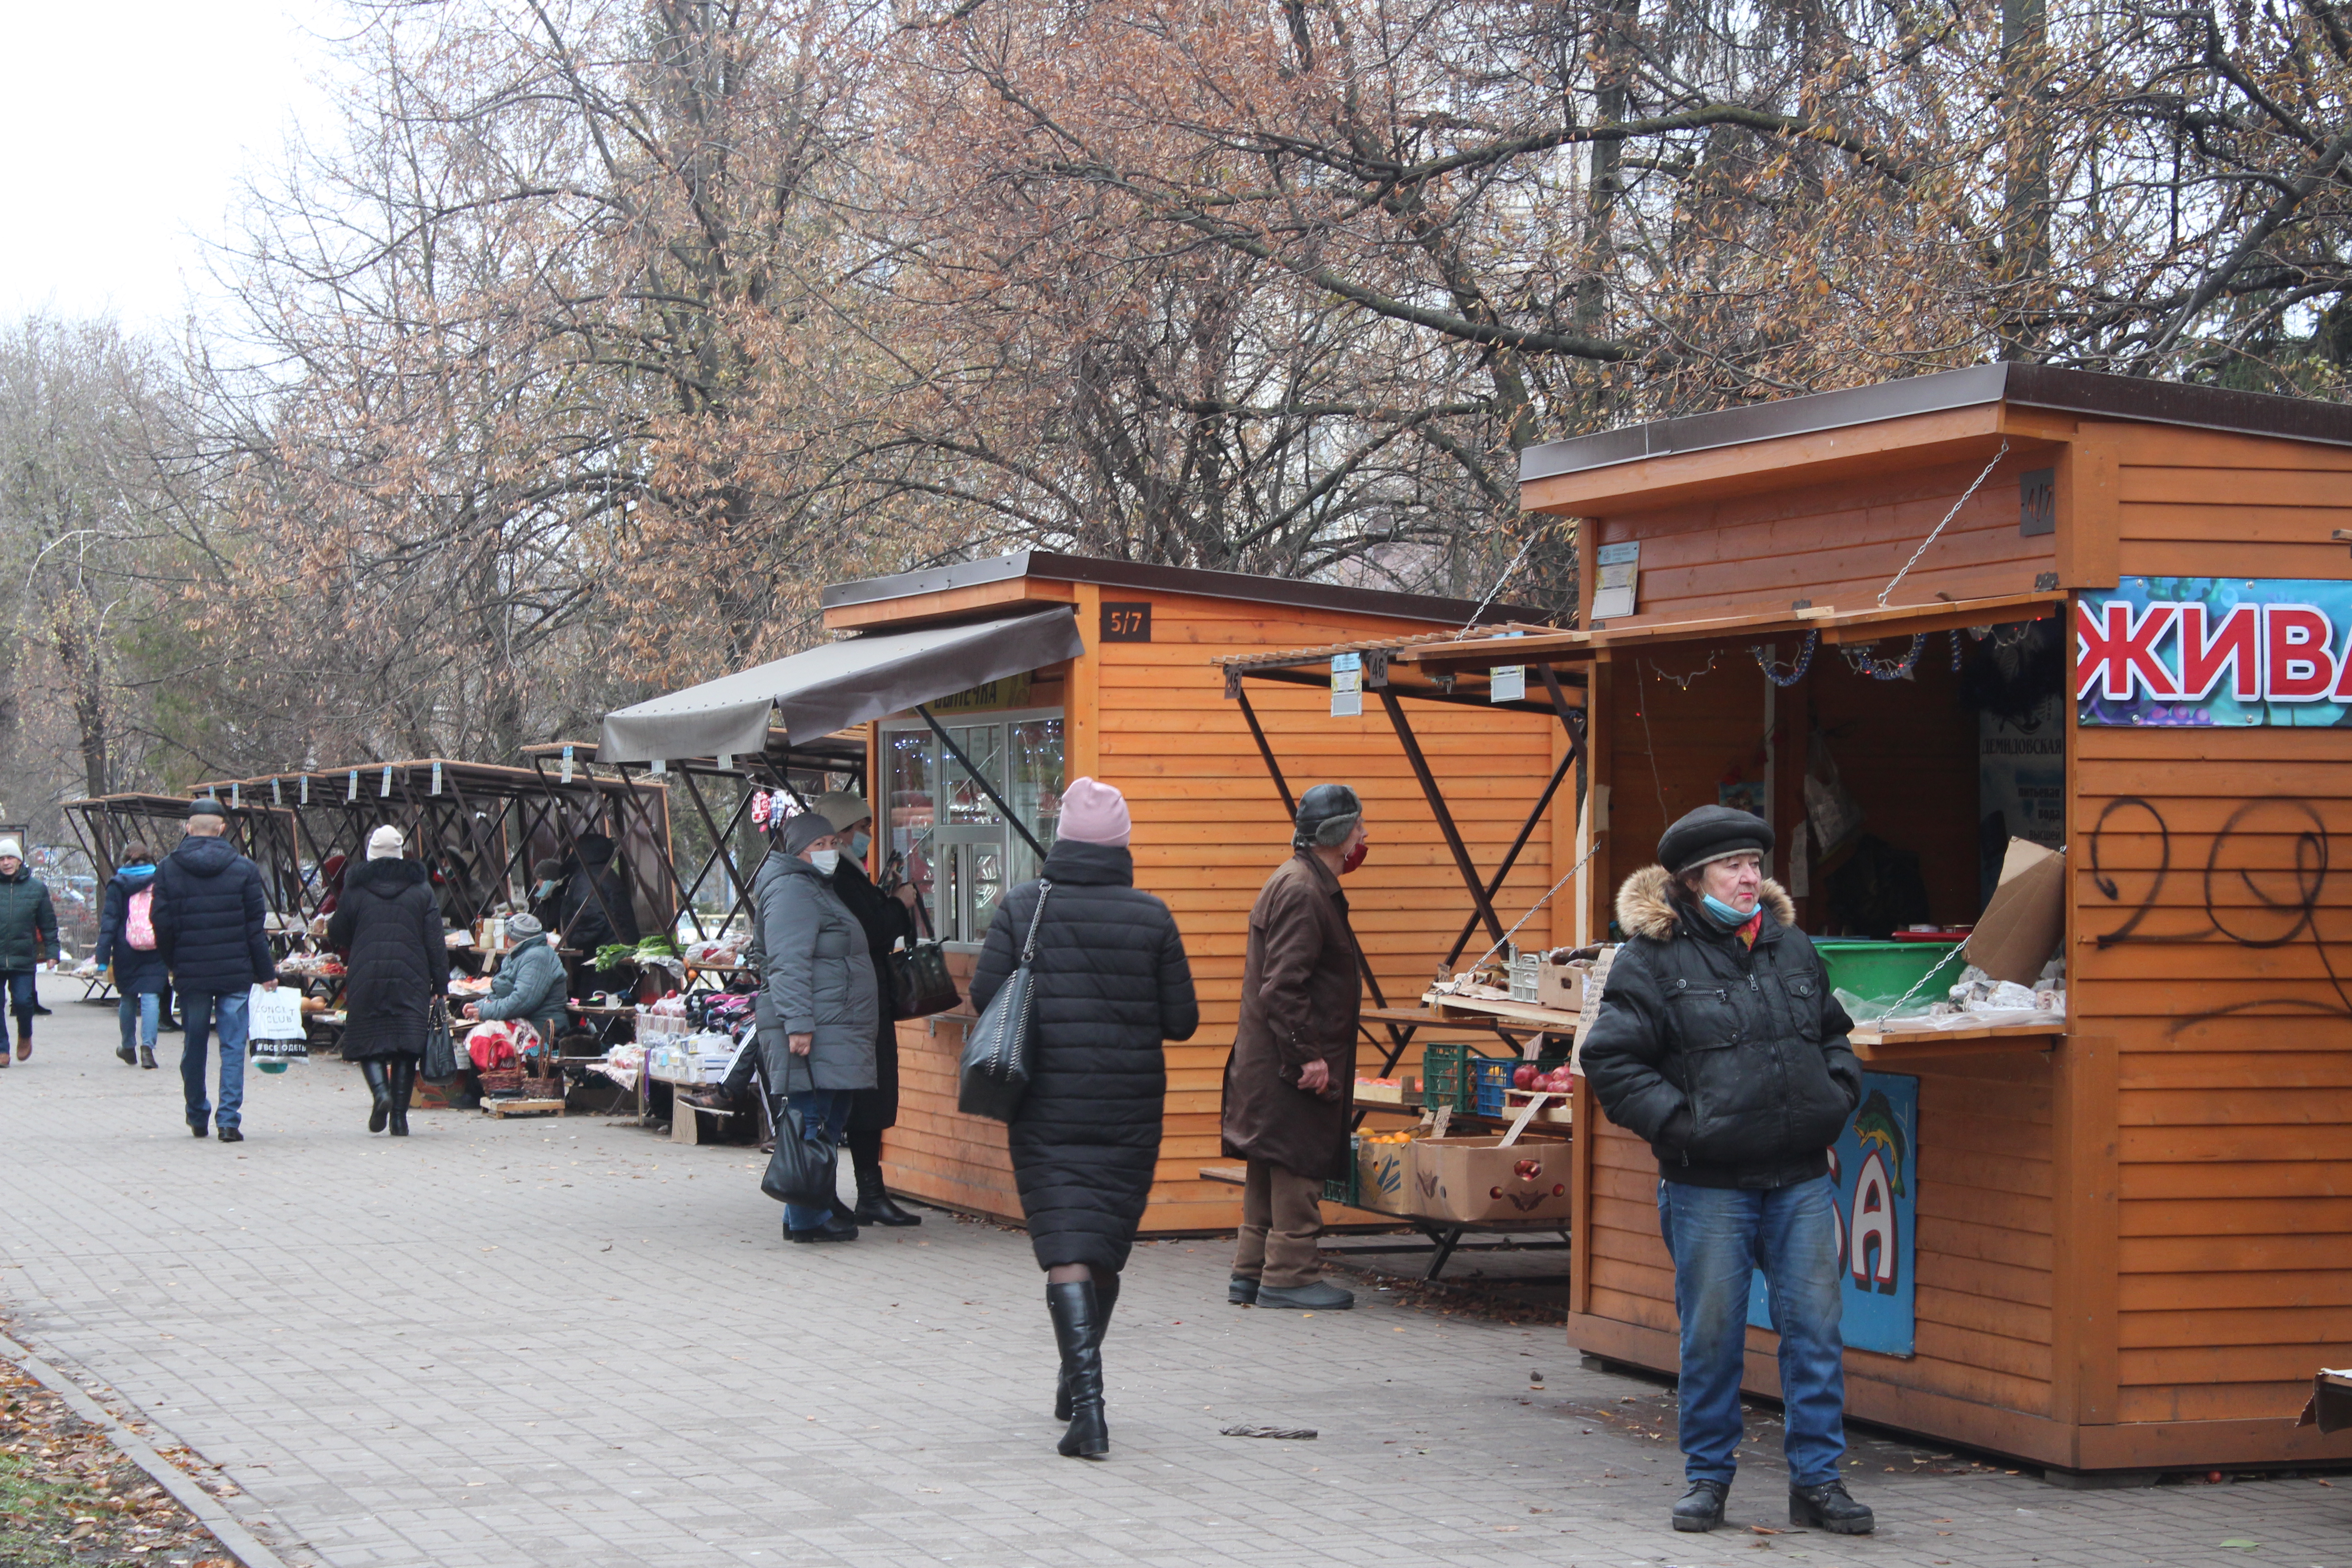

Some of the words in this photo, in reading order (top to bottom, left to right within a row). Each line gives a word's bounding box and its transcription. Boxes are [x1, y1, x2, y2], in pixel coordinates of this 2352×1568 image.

[2027, 484, 2053, 522] 4/7
[1111, 612, 1142, 635] 5/7
[1372, 657, 1384, 680] 46
[1228, 672, 1239, 693] 45
[1981, 737, 2062, 755] ДЕМИДОВСКАЯ
[2018, 786, 2061, 799] питьевая
[2038, 808, 2061, 822] вода
[2029, 826, 2061, 841] высшей
[267, 1015, 293, 1024] CLUB
[256, 1043, 279, 1053] #ВСЕ
